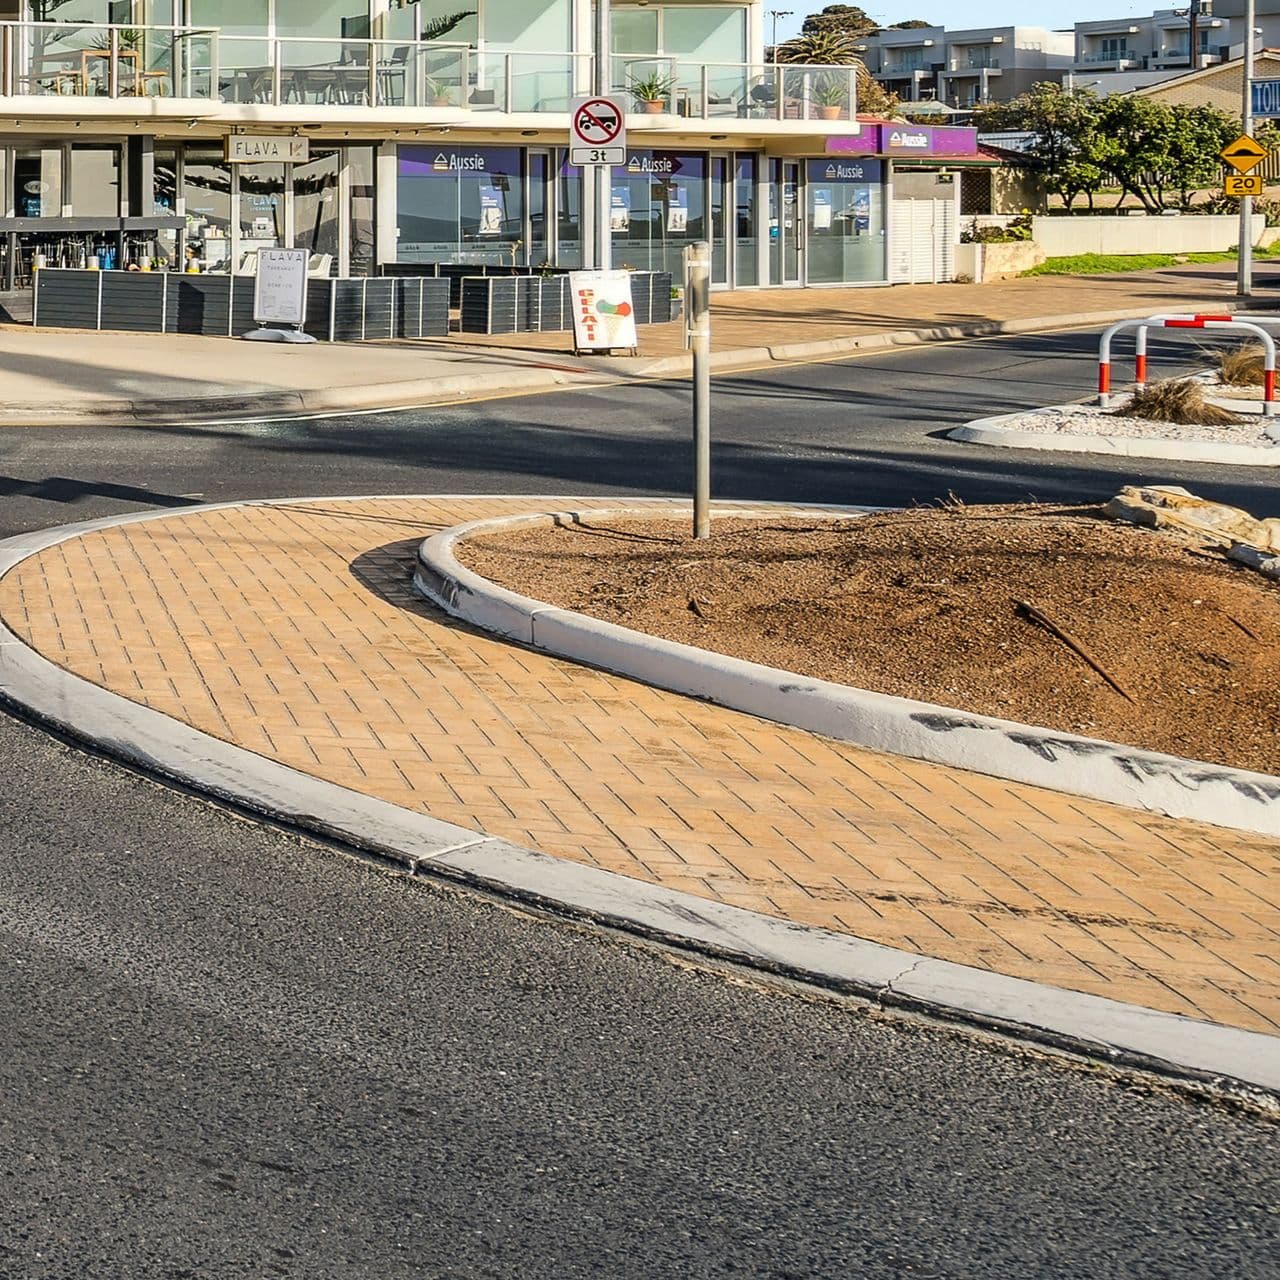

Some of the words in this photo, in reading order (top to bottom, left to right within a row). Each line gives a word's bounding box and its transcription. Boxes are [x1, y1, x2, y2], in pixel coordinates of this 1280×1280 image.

[901, 132, 928, 148] Aussie
[235, 141, 278, 156] FLAVA
[590, 150, 607, 162] 3t
[449, 153, 485, 170] Aussie
[641, 157, 673, 172] Aussie
[836, 164, 864, 179] Aussie
[1232, 178, 1255, 189] 20
[261, 251, 302, 261] FLAVA
[578, 289, 598, 341] GELATI
